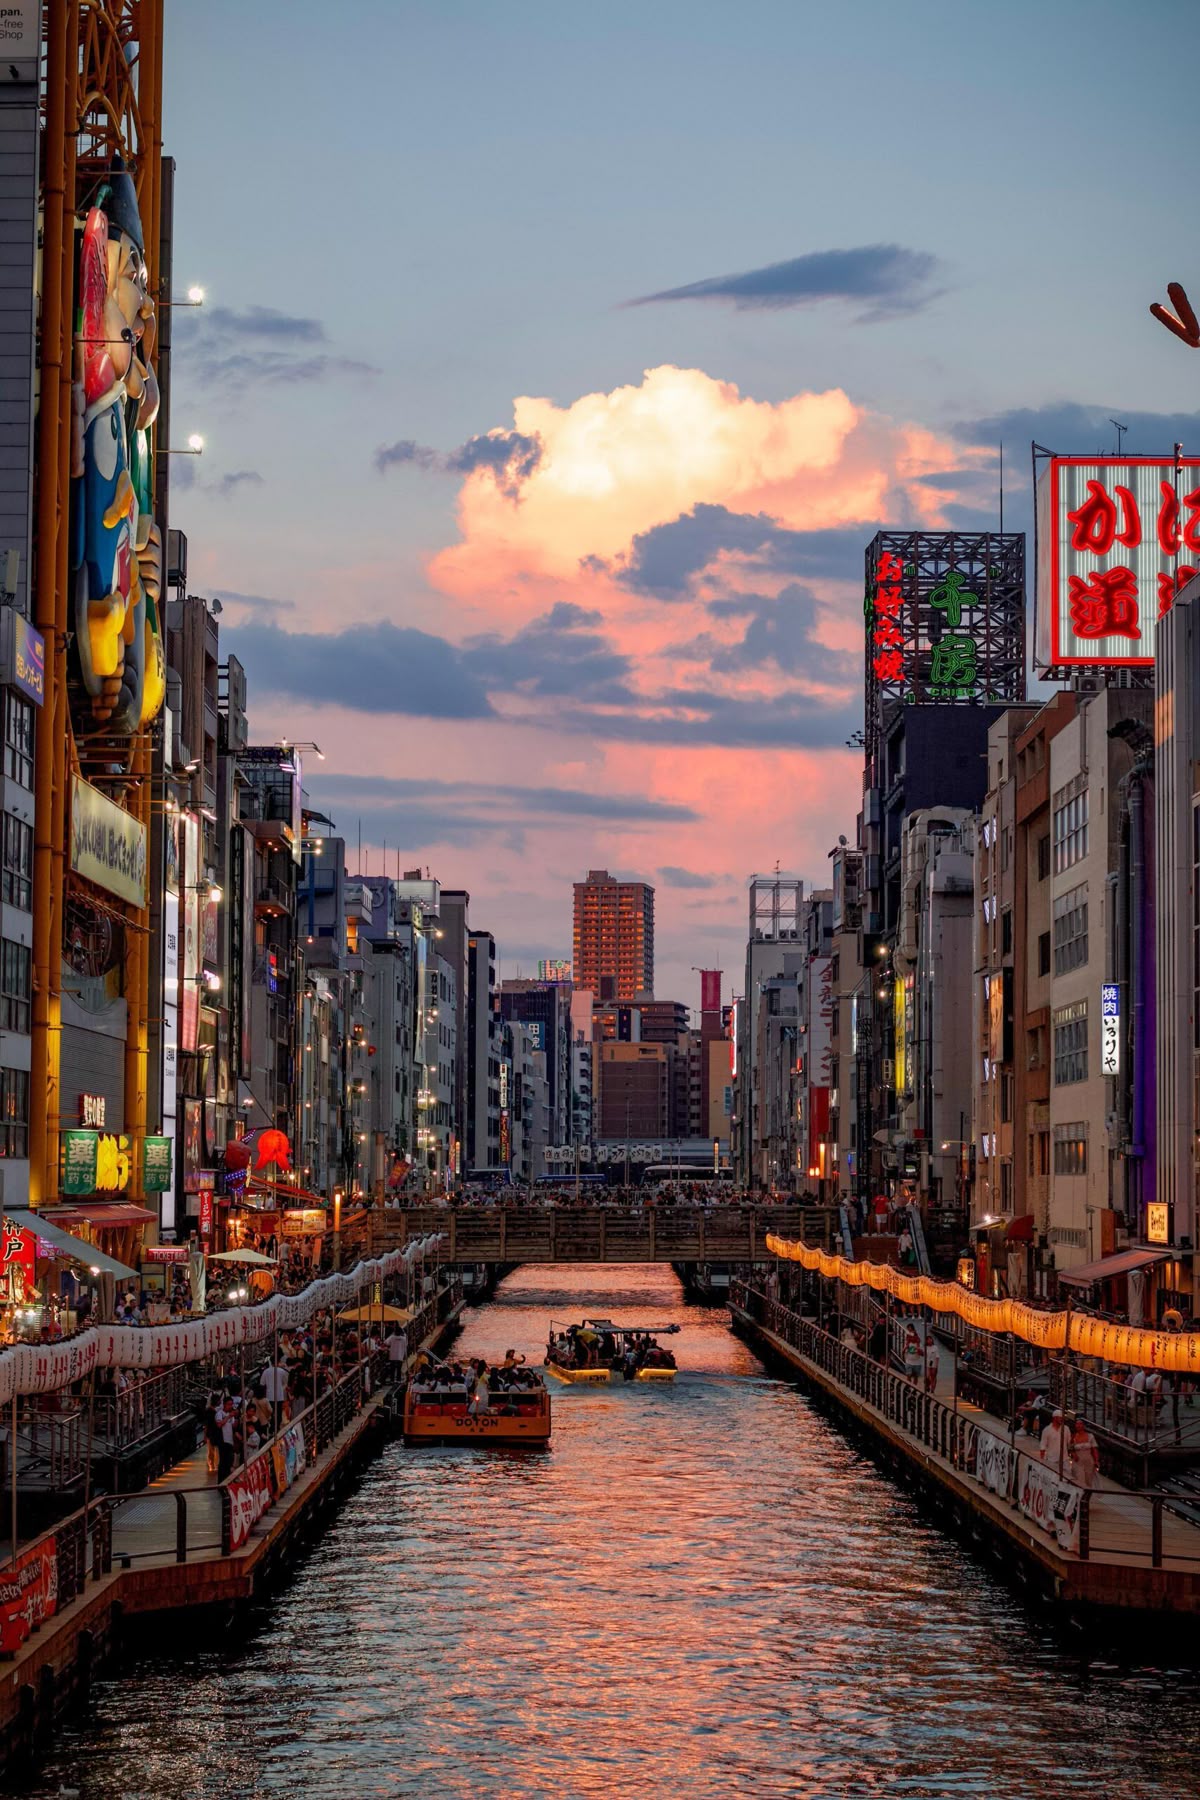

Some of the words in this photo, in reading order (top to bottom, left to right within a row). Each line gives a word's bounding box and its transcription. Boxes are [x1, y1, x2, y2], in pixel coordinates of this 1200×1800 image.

[873, 551, 906, 681] お好み焼
[929, 571, 979, 685] 千房
[930, 687, 977, 698] CHIBO
[1103, 987, 1117, 1015] 焼肉
[1103, 1018, 1117, 1073] いろりや
[68, 1138, 95, 1165] 薬
[146, 1144, 169, 1166] 薬
[153, 1251, 175, 1261] TICKET
[455, 1418, 498, 1427] DOTON
